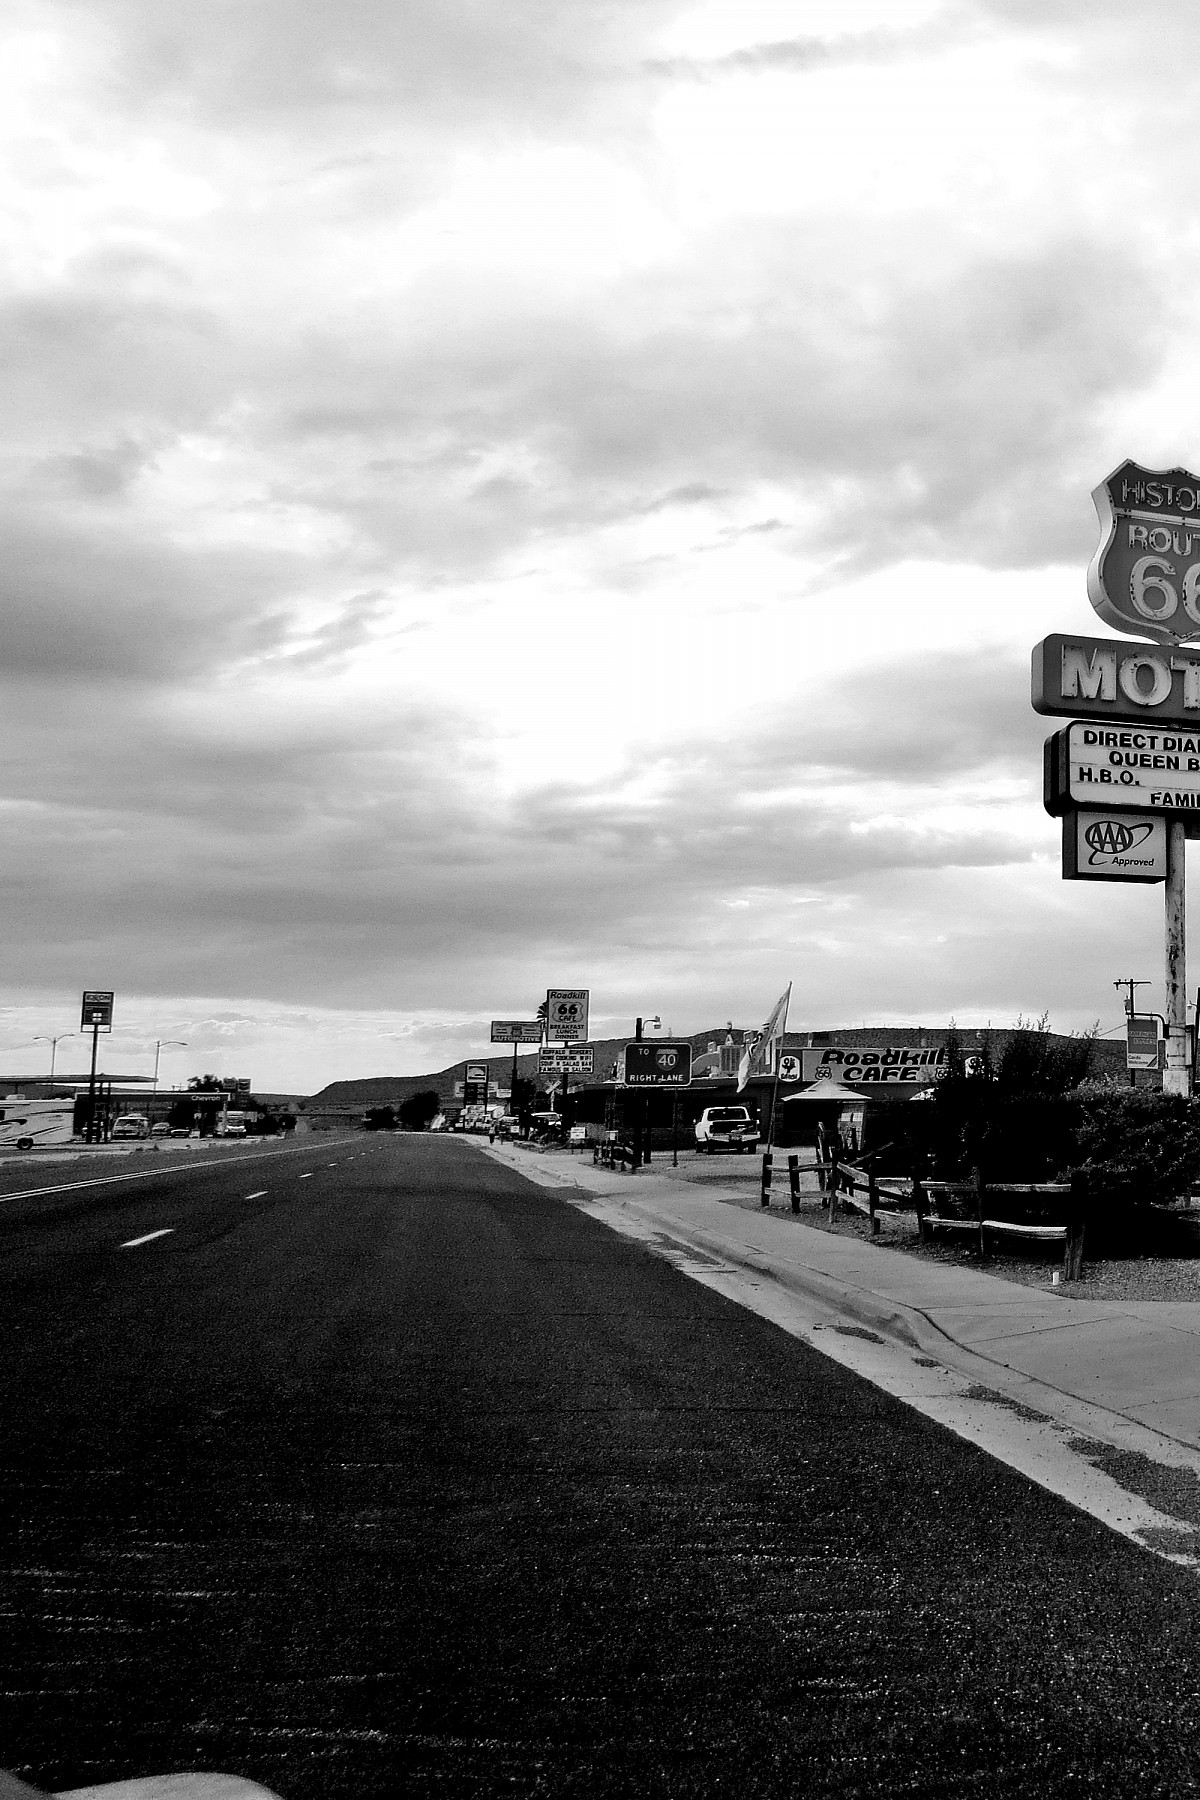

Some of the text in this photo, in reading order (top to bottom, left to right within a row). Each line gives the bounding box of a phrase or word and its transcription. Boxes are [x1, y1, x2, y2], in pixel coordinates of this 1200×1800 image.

[1084, 730, 1159, 750] DIRECT
[1109, 751, 1180, 770] QUEEN
[1079, 767, 1140, 786] H.B.O.
[1087, 821, 1132, 853] AAA
[1112, 856, 1154, 867] Approved
[550, 991, 586, 999] Roadkill
[557, 1004, 578, 1015] 66
[658, 1054, 676, 1066] 40
[821, 1049, 946, 1065] Roadkill
[630, 1074, 684, 1082] RIGHT LANE
[817, 1068, 830, 1078] 66
[842, 1066, 921, 1081] CAFE
